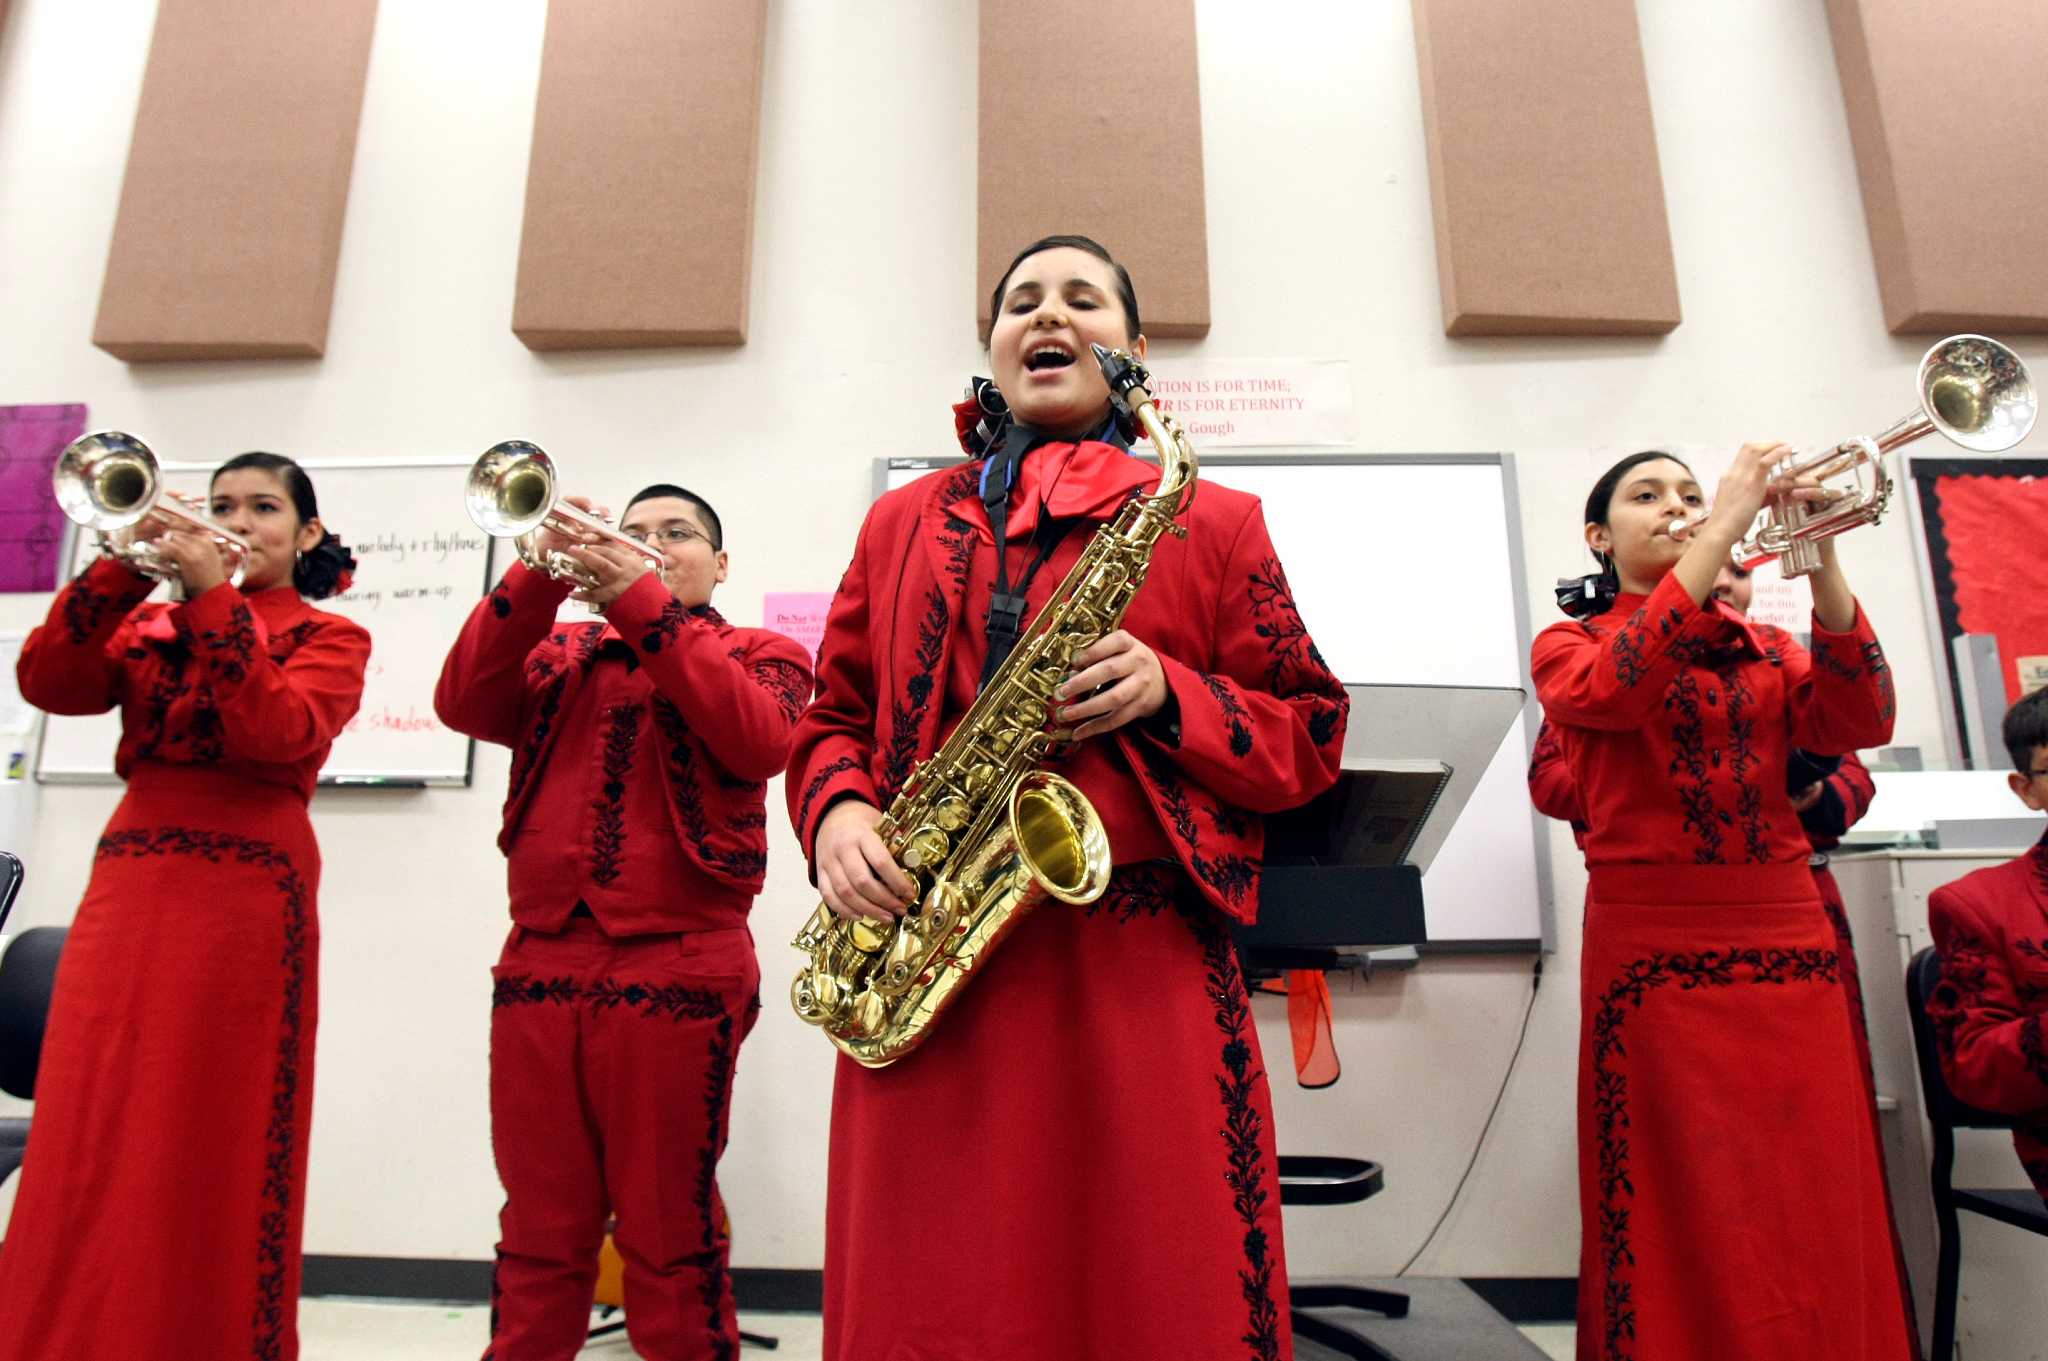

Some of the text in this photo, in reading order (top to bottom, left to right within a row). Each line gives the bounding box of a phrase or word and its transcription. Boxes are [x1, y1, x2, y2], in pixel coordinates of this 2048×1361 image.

[1197, 380, 1210, 393] IS
[1214, 380, 1245, 393] FOR
[1248, 378, 1291, 393] TIME;
[1178, 398, 1191, 411] IS
[1195, 398, 1225, 411] FOR
[1229, 397, 1305, 411] ETERNITY
[1188, 420, 1235, 437] Gough
[356, 533, 404, 562] melody
